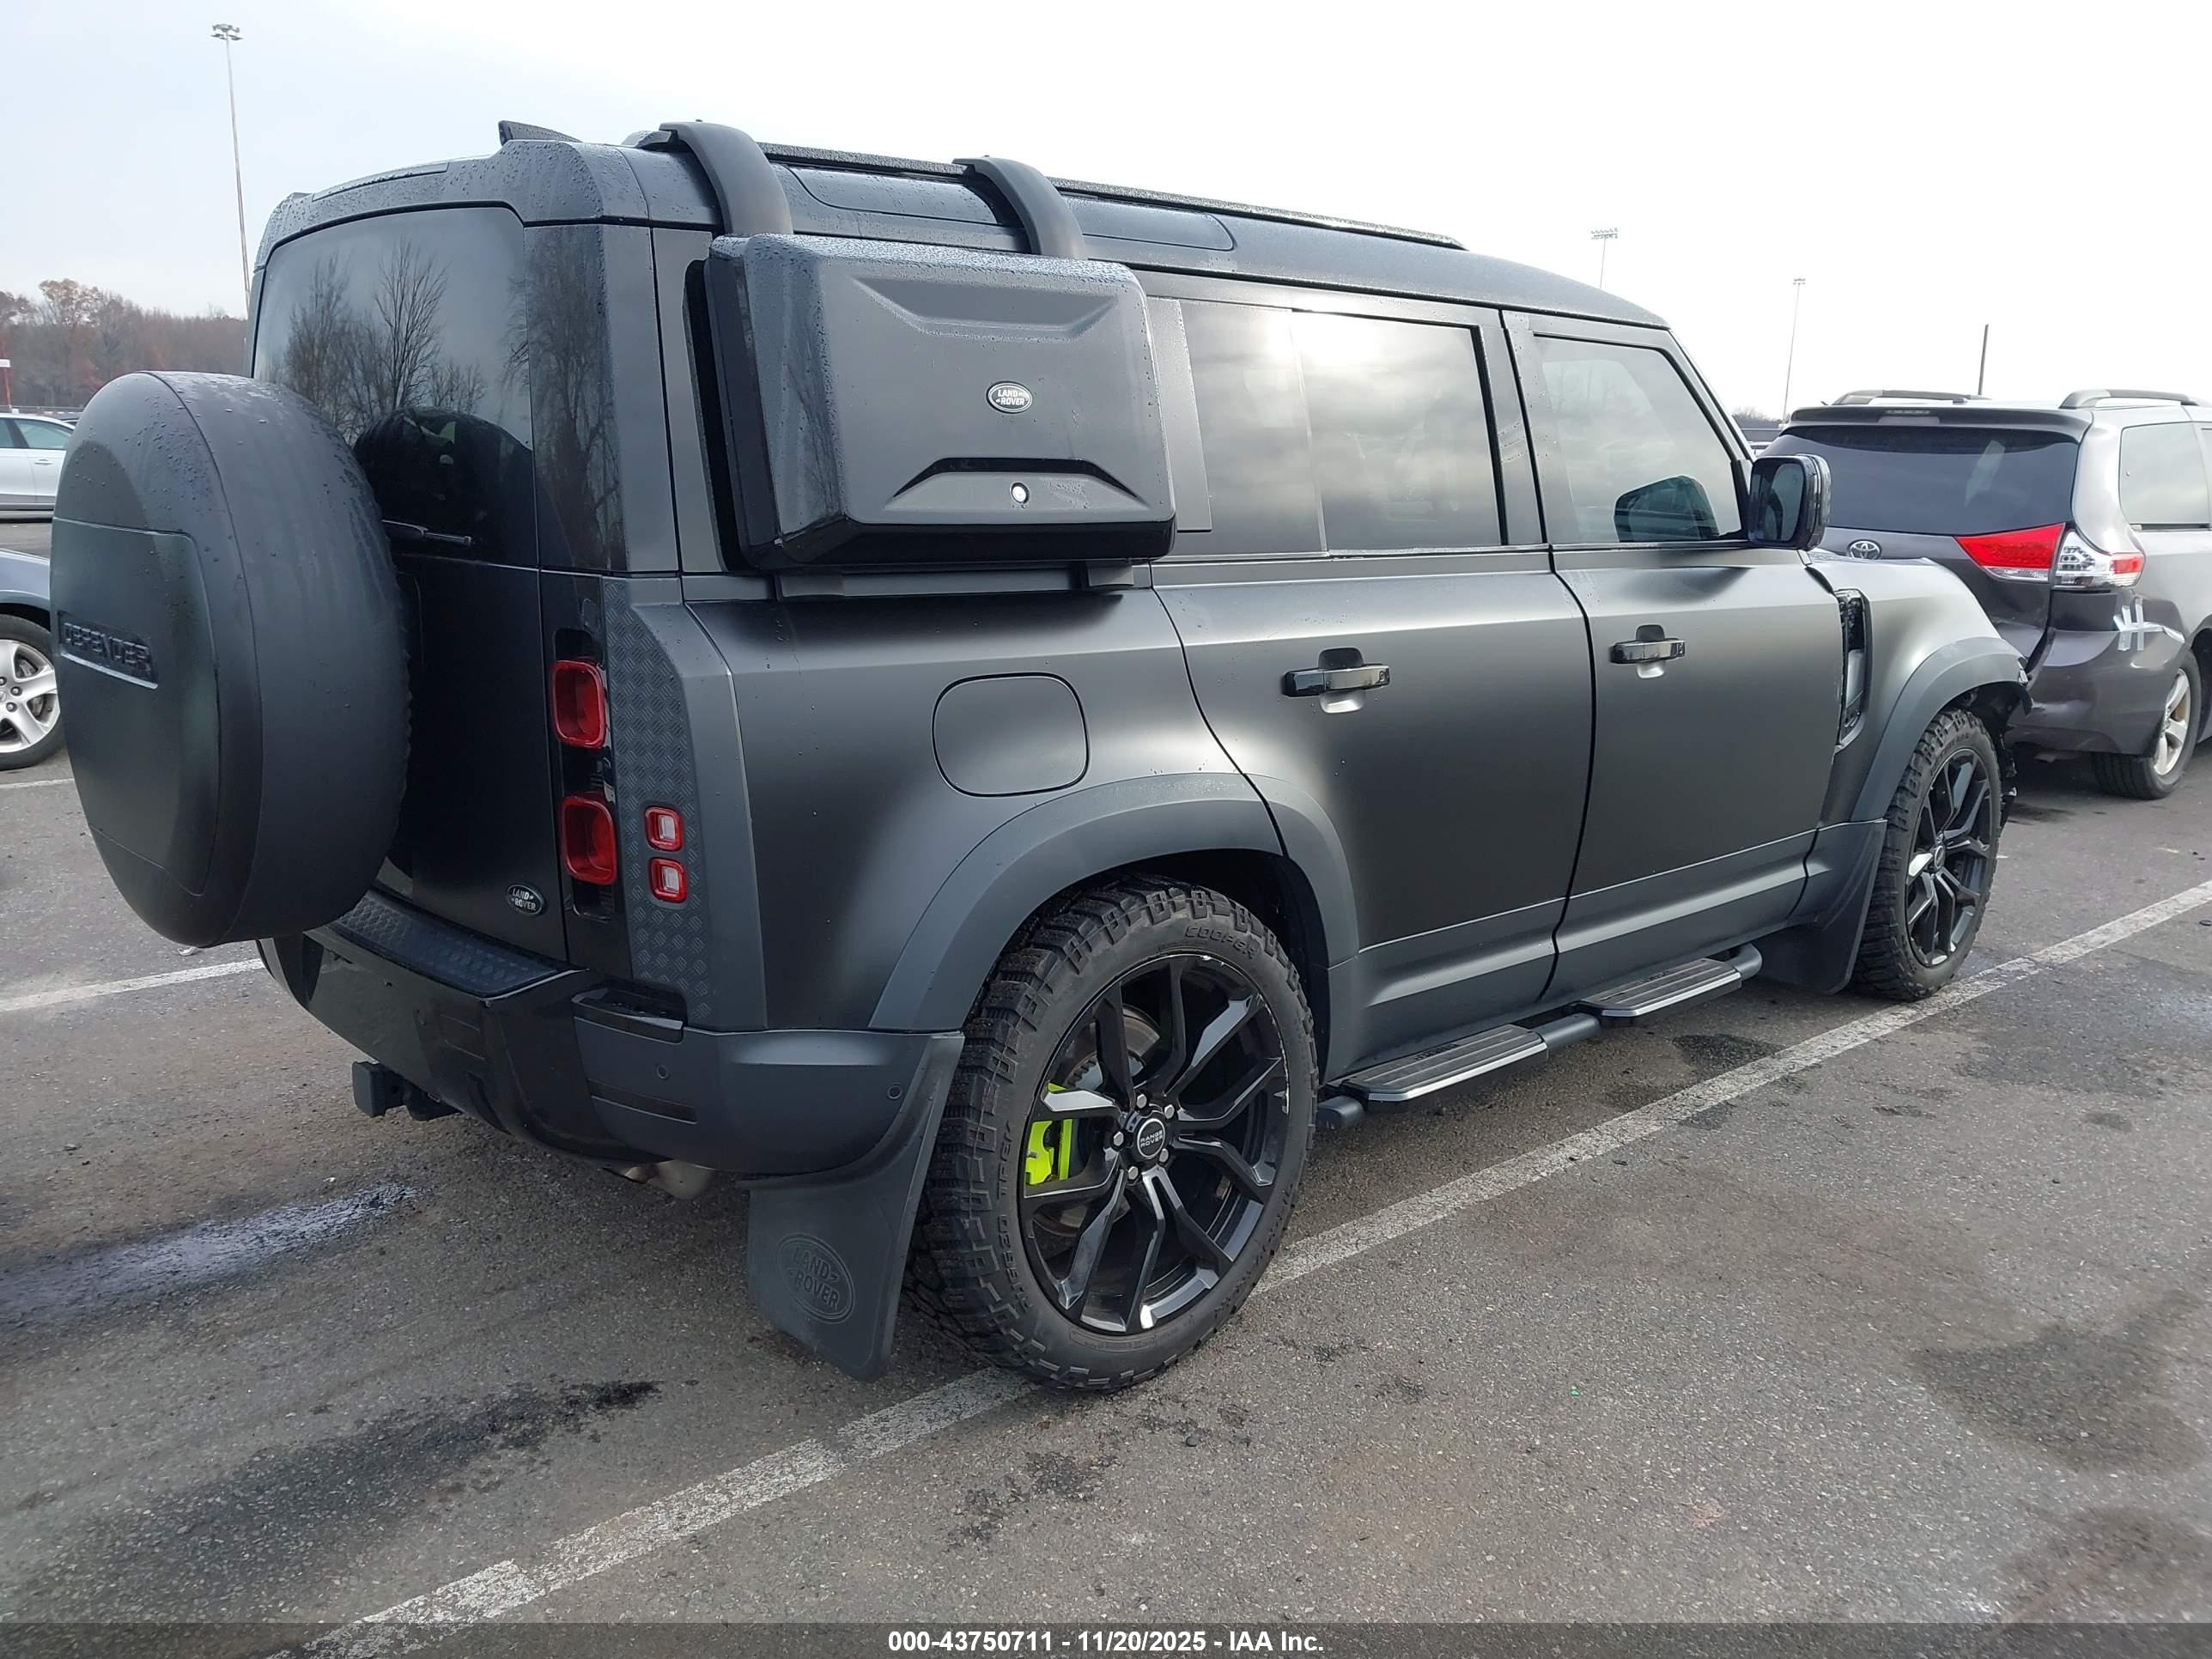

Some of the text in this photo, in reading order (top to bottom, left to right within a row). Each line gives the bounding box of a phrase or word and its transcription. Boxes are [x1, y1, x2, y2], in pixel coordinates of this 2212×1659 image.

[997, 389, 1018, 398] LAND
[1000, 397, 1025, 406] ROVER
[63, 622, 151, 668] DEFENDER
[513, 888, 530, 900] LAND
[515, 897, 537, 911] ROVER
[1185, 927, 1256, 960] COOPER
[1140, 1129, 1163, 1143] RANGE
[1140, 1134, 1164, 1148] ROVER
[792, 1246, 830, 1281] LAND
[795, 1268, 840, 1310] ROVER
